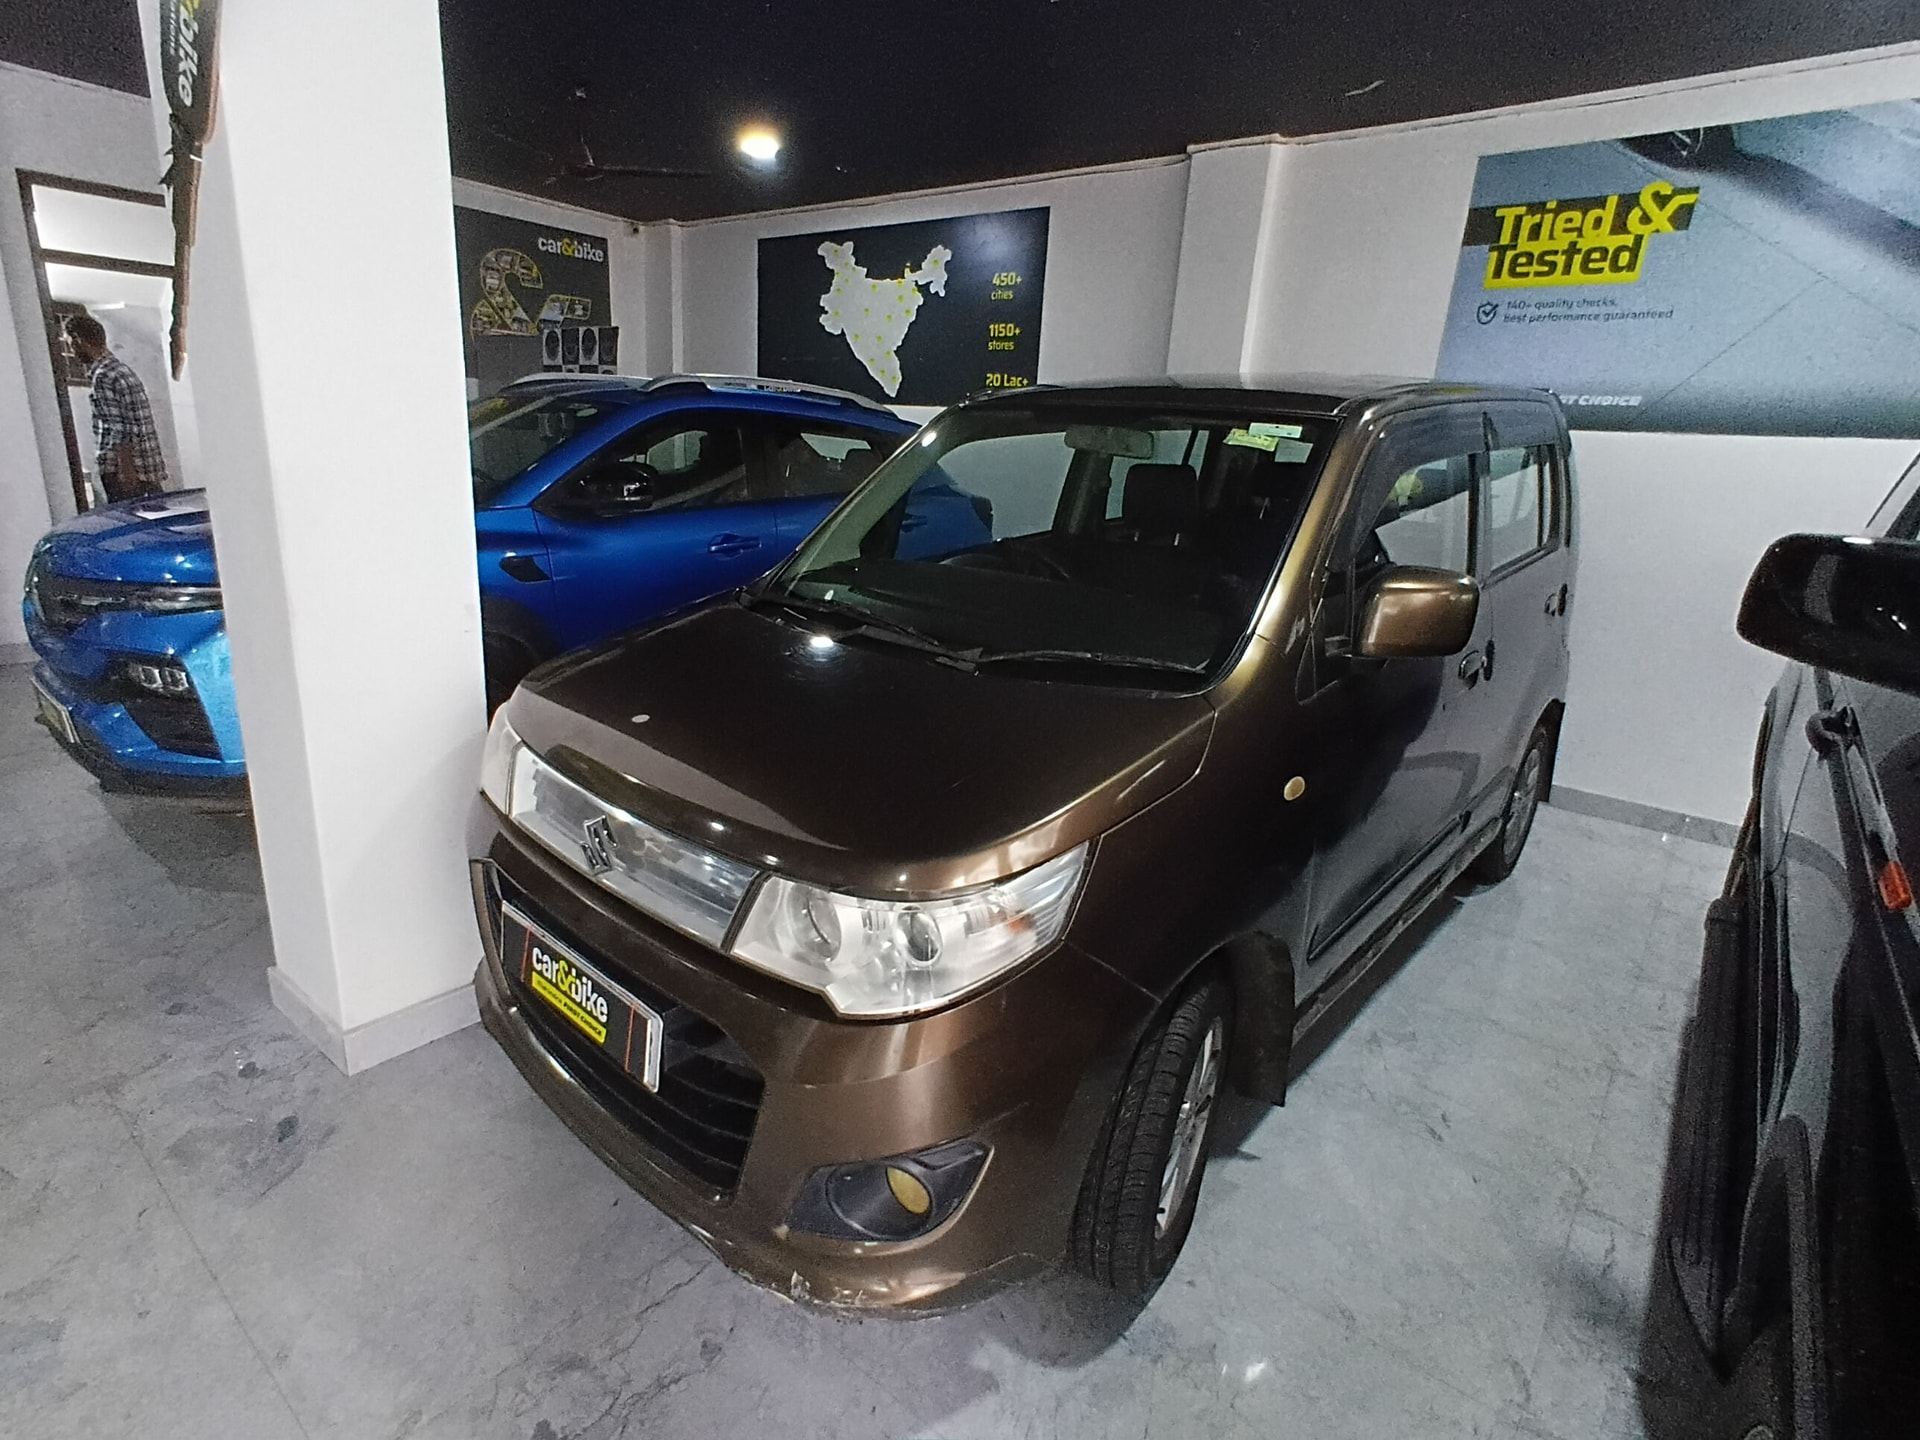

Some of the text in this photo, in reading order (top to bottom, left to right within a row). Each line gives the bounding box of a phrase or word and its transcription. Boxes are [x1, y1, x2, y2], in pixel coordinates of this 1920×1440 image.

[1495, 181, 1698, 245] Tried &
[538, 237, 604, 263] car&bike
[1488, 234, 1645, 279] Tested
[992, 272, 1022, 286] 450+
[991, 289, 1014, 300] cities
[1534, 298, 1574, 311] quality
[1503, 308, 1674, 324] Best performance guaranteed
[989, 323, 1021, 337] 1150+
[988, 341, 1015, 351] stores
[1003, 374, 1029, 388] Lac+
[1578, 395, 1642, 406] CHOICE
[532, 947, 608, 1023] car&bike
